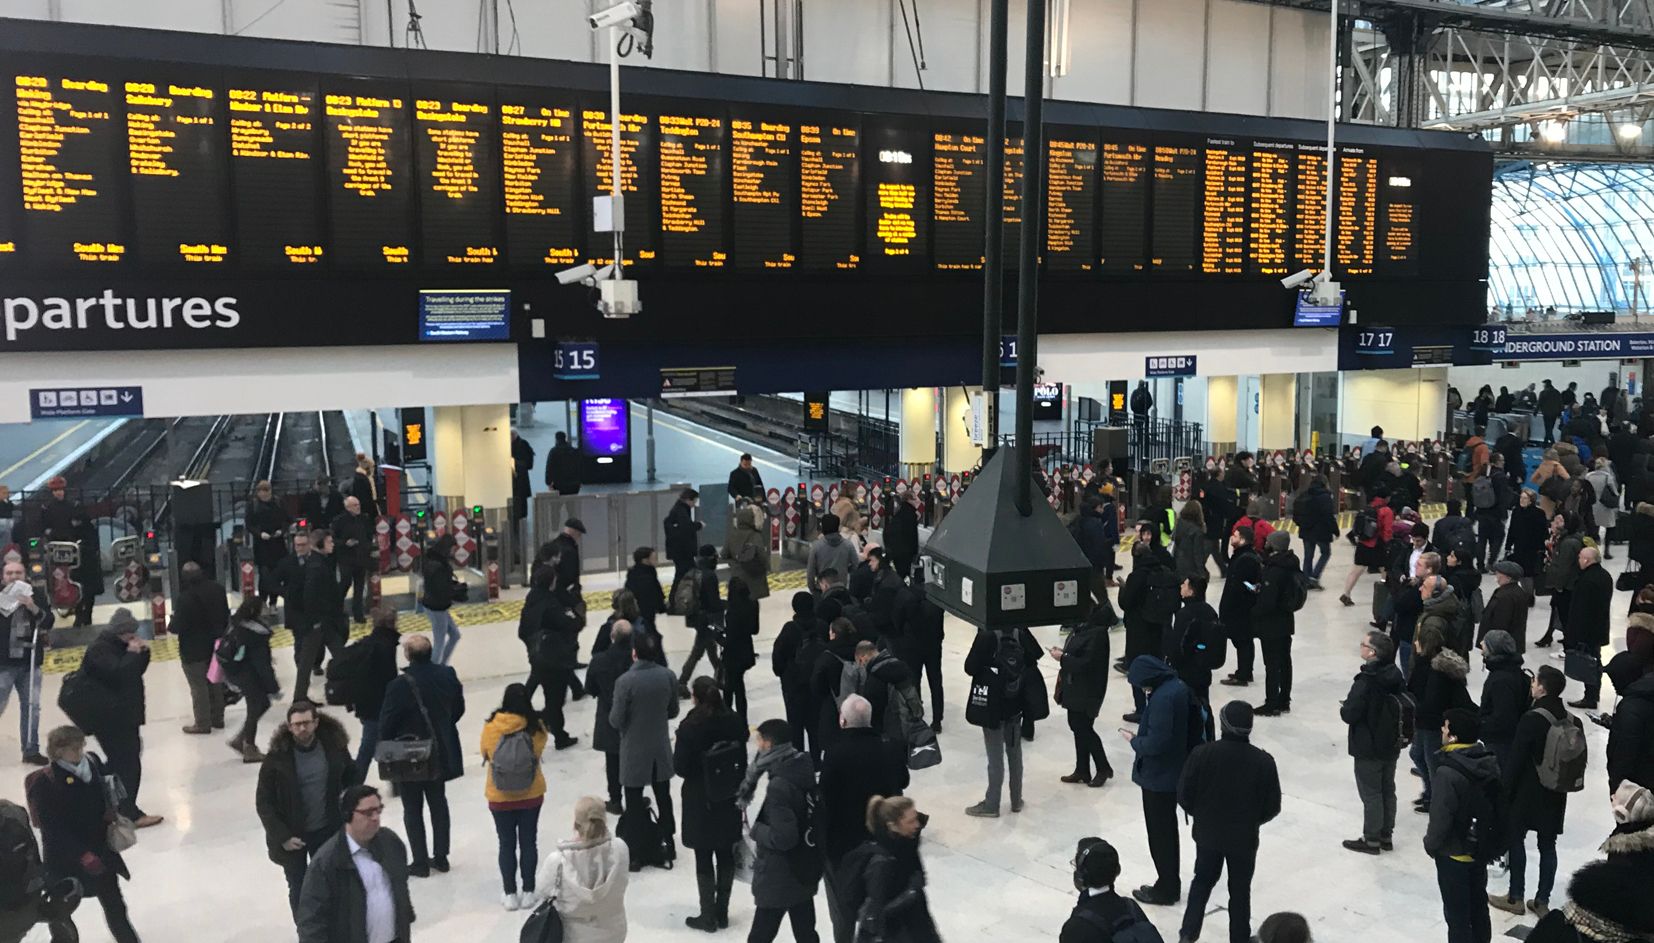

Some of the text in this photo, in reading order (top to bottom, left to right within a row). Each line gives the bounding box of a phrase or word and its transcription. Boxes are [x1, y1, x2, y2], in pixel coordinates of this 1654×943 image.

[62, 79, 108, 92] Boarding
[169, 85, 213, 98] Boarding
[452, 102, 488, 114] Boarding
[502, 116, 548, 127] Strawberry
[618, 114, 647, 124] oarding
[660, 126, 699, 136] Teddington
[761, 122, 790, 133] Boarding
[73, 242, 105, 253] South
[180, 243, 210, 254] South
[285, 246, 312, 256] South
[383, 246, 409, 255] South
[467, 247, 491, 256] South
[550, 249, 572, 257] South
[426, 296, 454, 304] Travelling
[455, 296, 474, 304] during
[4, 288, 241, 341] partures
[1359, 333, 1393, 347] 17 17
[1473, 330, 1505, 344] 18 18
[1578, 340, 1620, 352] STATION
[554, 350, 564, 368] 15
[569, 350, 596, 370] 15
